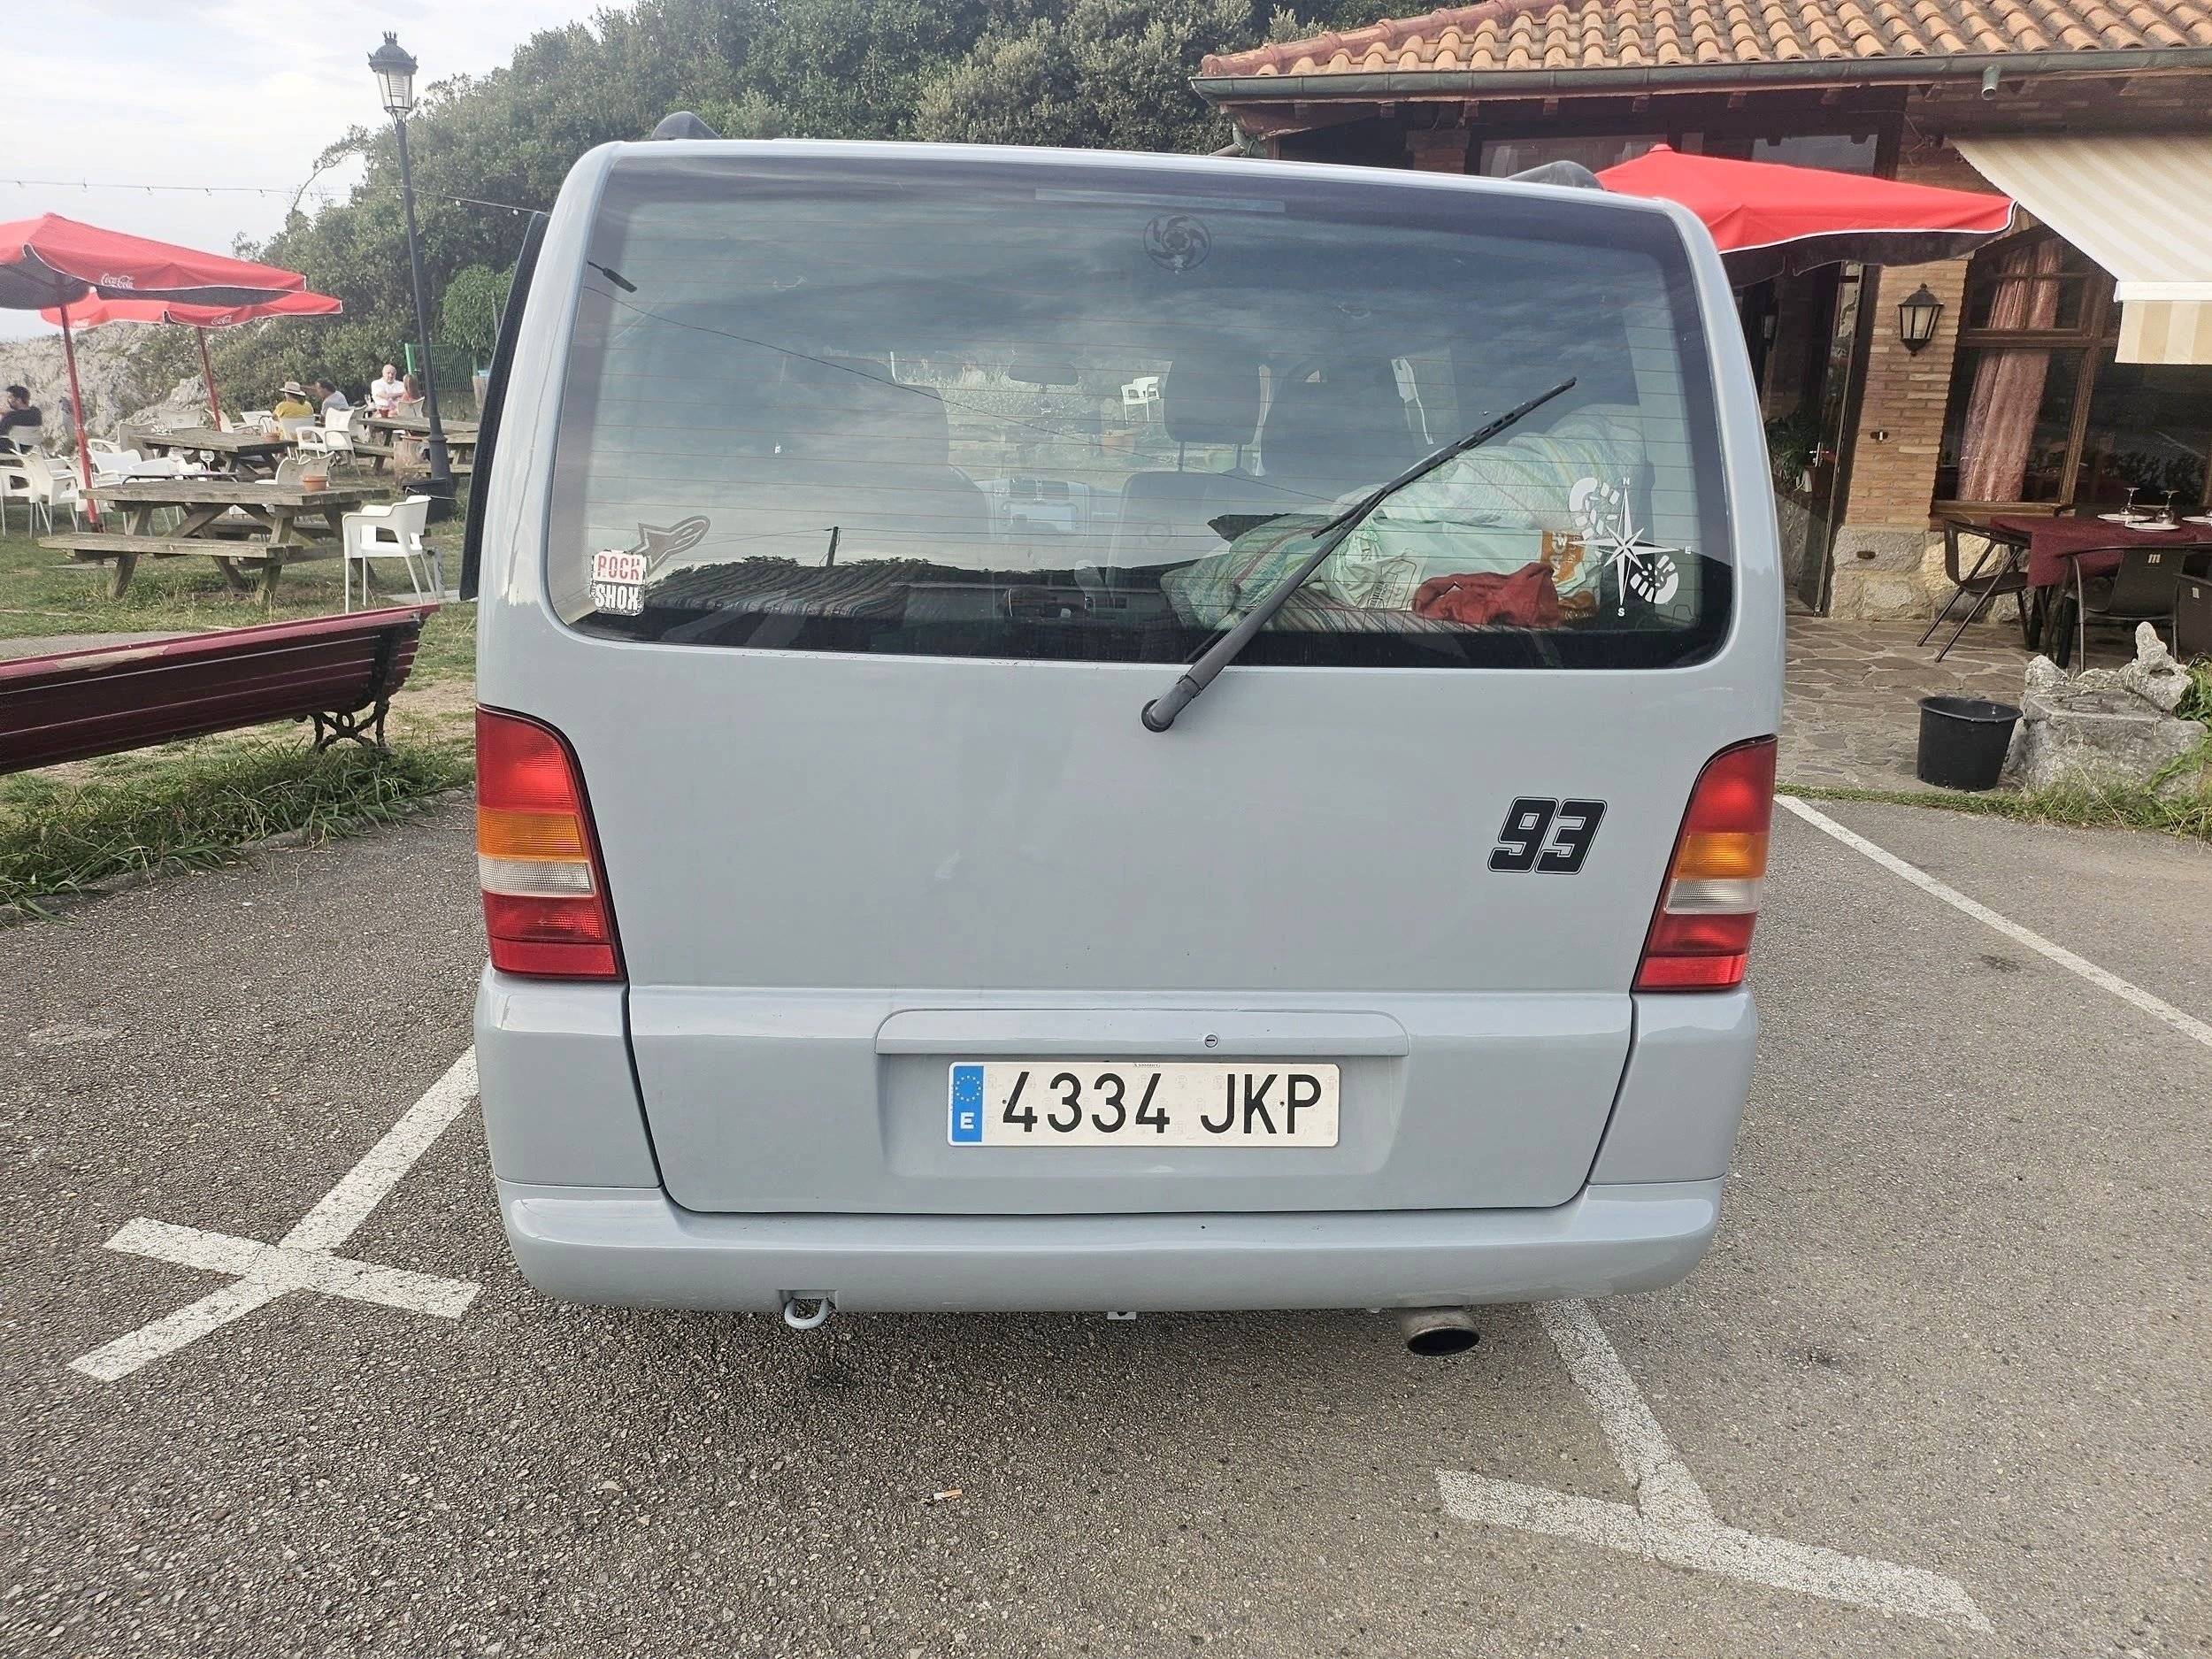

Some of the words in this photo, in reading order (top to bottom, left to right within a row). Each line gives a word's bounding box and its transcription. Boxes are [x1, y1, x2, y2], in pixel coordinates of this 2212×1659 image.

[1623, 477, 1631, 486] N
[1685, 546, 1692, 555] E
[597, 555, 641, 580] ROCK
[595, 583, 638, 611] SHOX
[1617, 607, 1625, 617] S
[1487, 796, 1608, 875] 93
[960, 1111, 975, 1130] E
[1002, 1071, 1171, 1133] 4334
[1200, 1073, 1322, 1134] JKP
